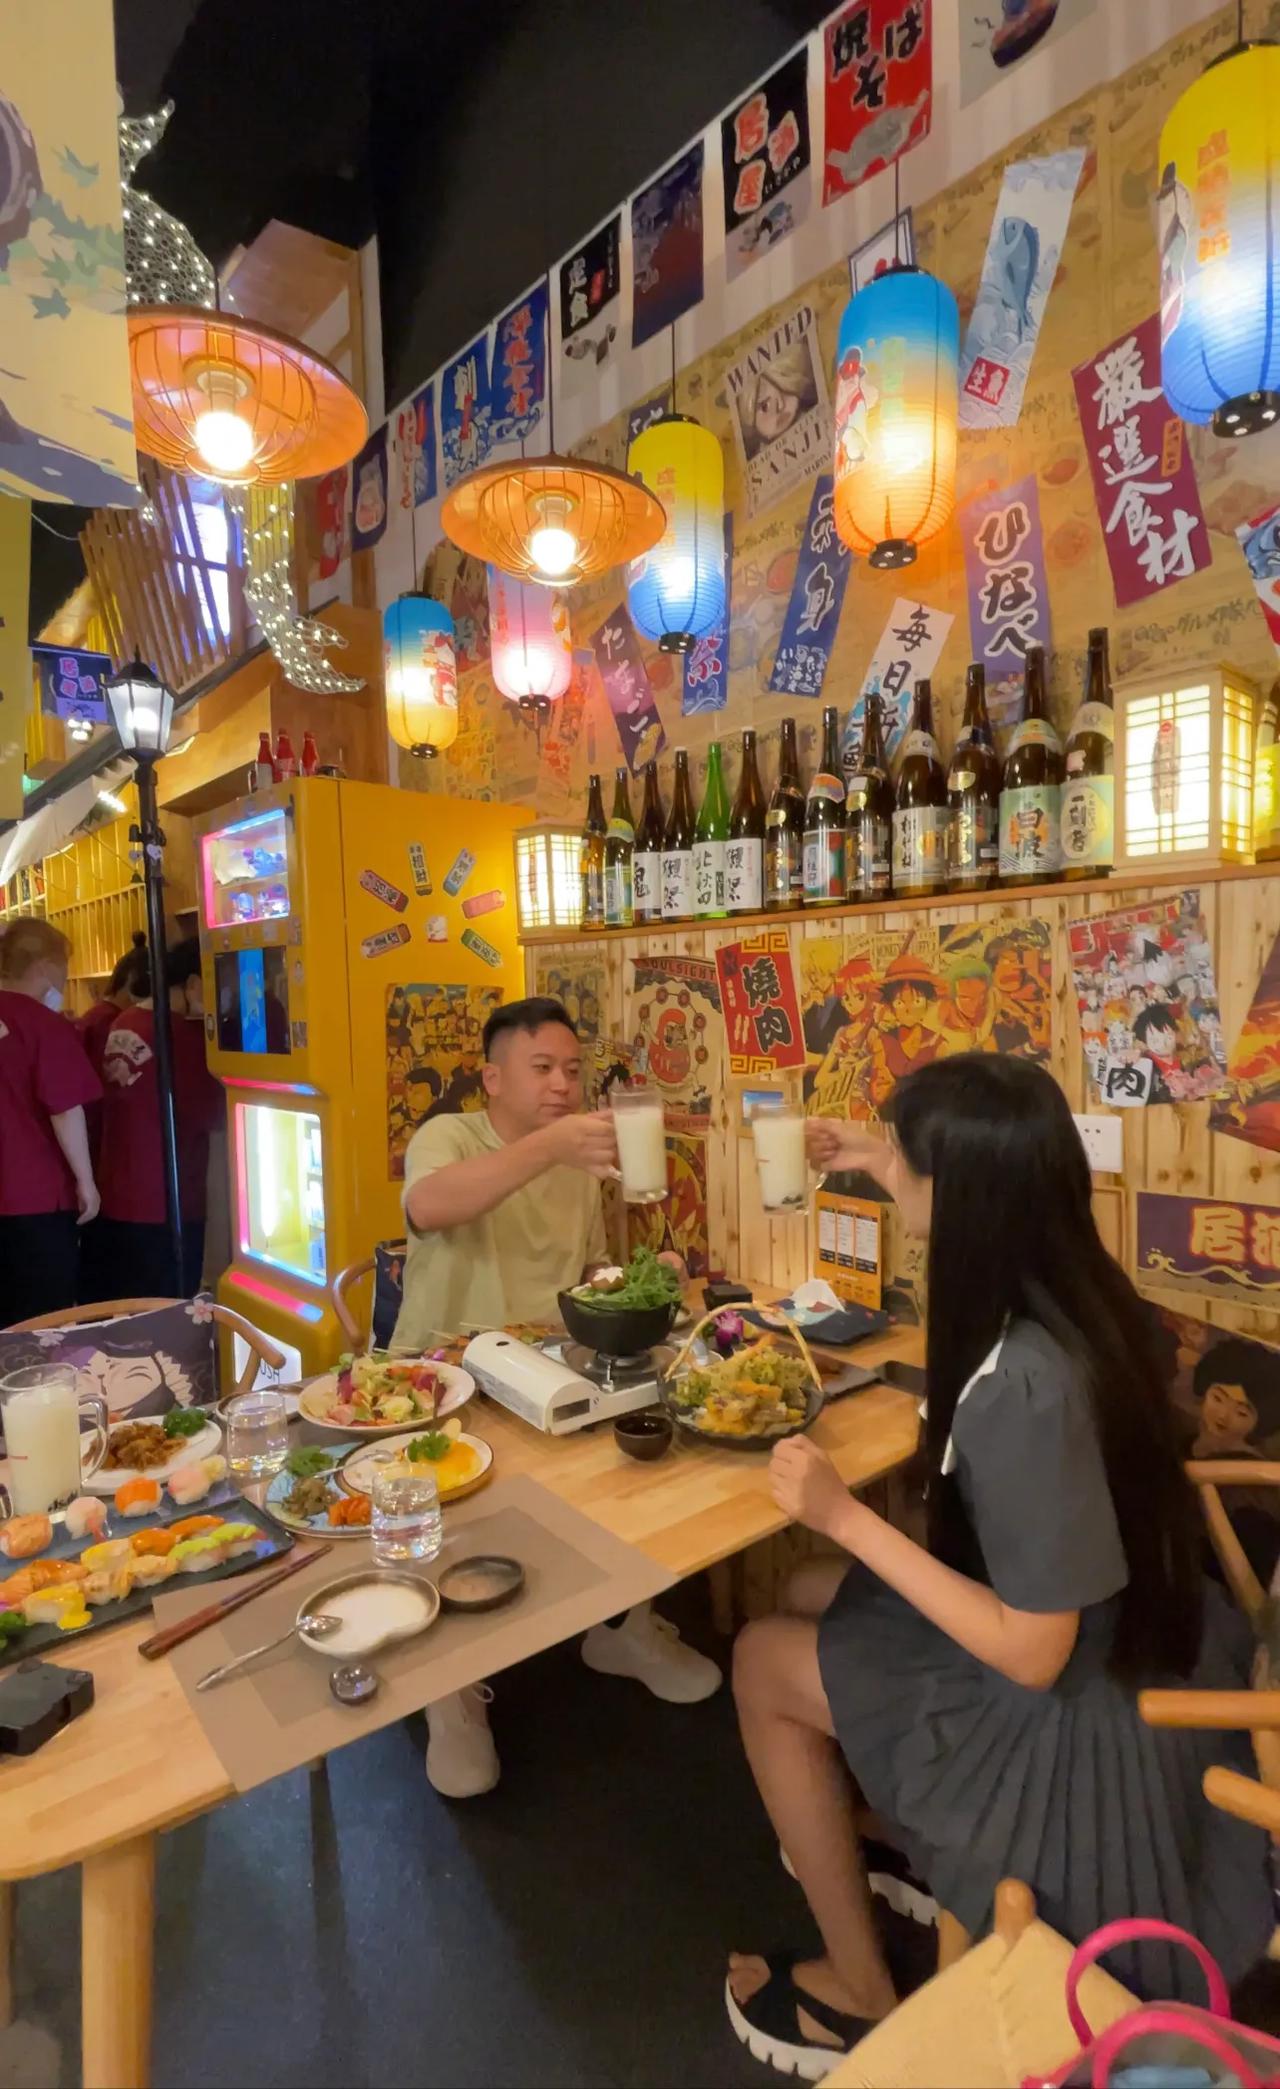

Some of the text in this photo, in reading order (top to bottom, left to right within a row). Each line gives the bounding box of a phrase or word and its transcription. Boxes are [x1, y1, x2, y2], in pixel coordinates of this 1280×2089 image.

[727, 307, 812, 393] WANTED
[751, 422, 821, 486] SANJI
[1106, 1062, 1147, 1099] 肉
